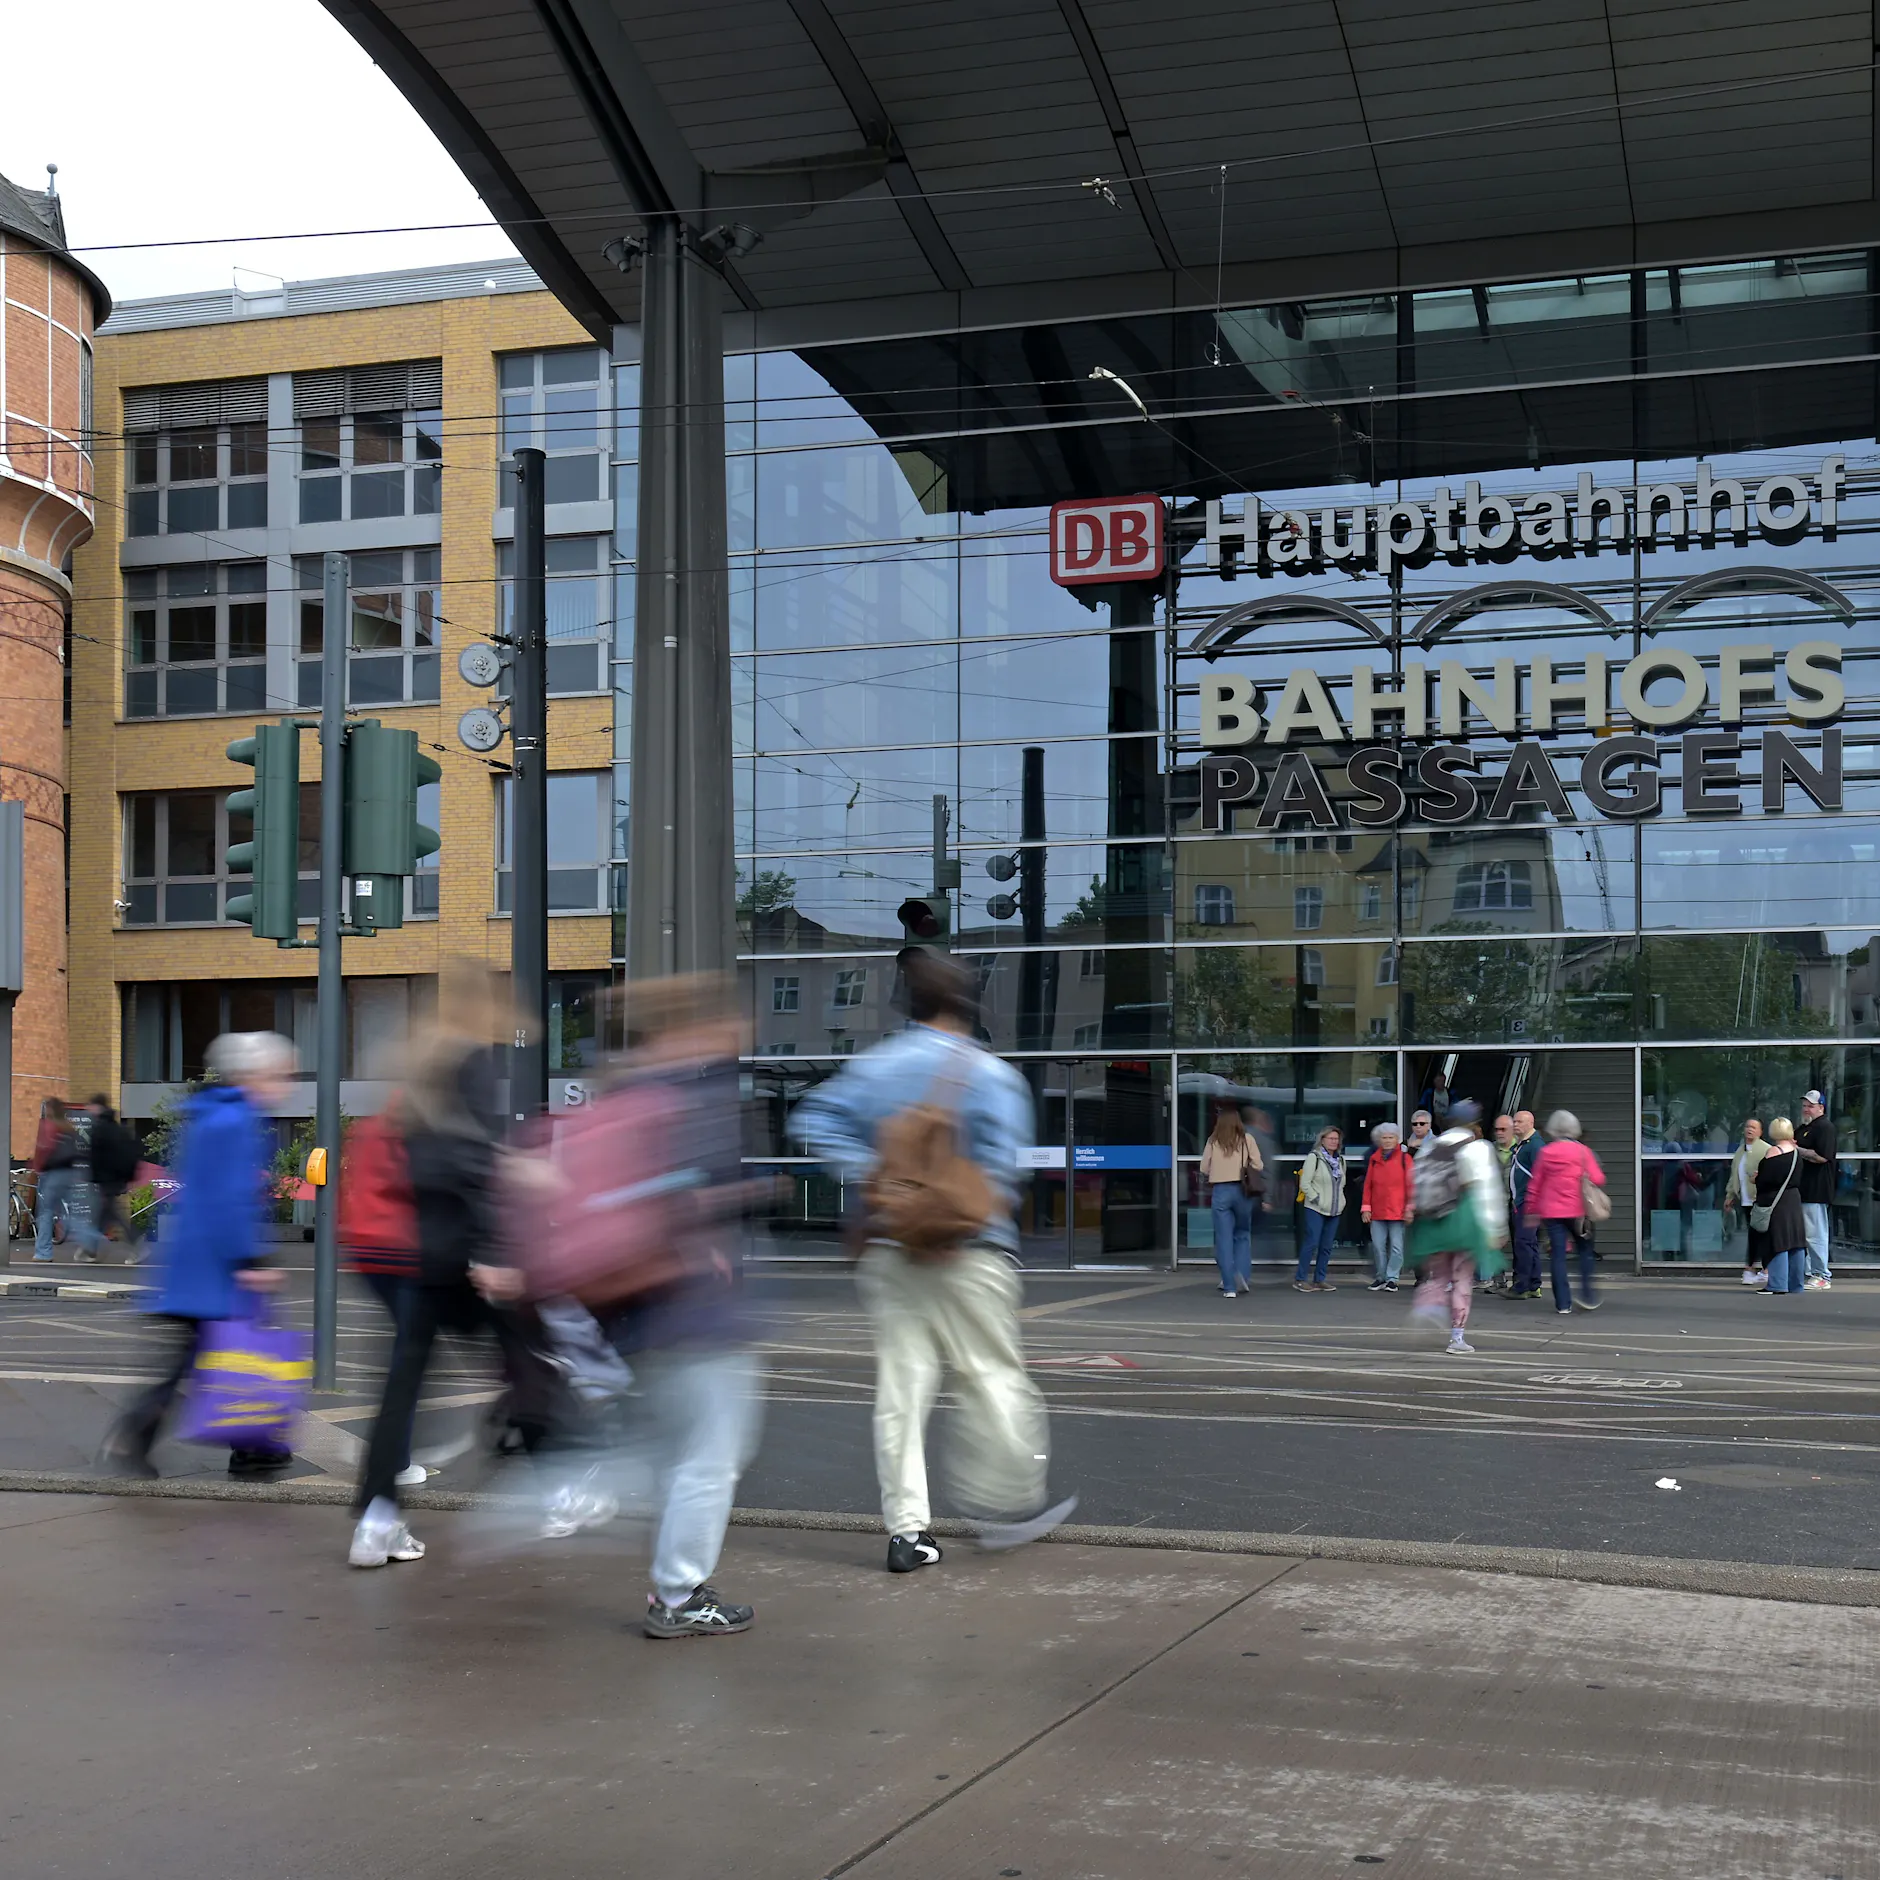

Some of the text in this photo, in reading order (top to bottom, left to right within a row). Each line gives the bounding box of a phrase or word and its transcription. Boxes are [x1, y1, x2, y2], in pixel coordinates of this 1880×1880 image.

[1064, 507, 1148, 569] DB
[1204, 453, 1846, 576] Hauptbahnhof
[1200, 641, 1845, 747] BAHNHOFS
[1200, 728, 1844, 831] PASSAGEN
[515, 1029, 526, 1038] 12
